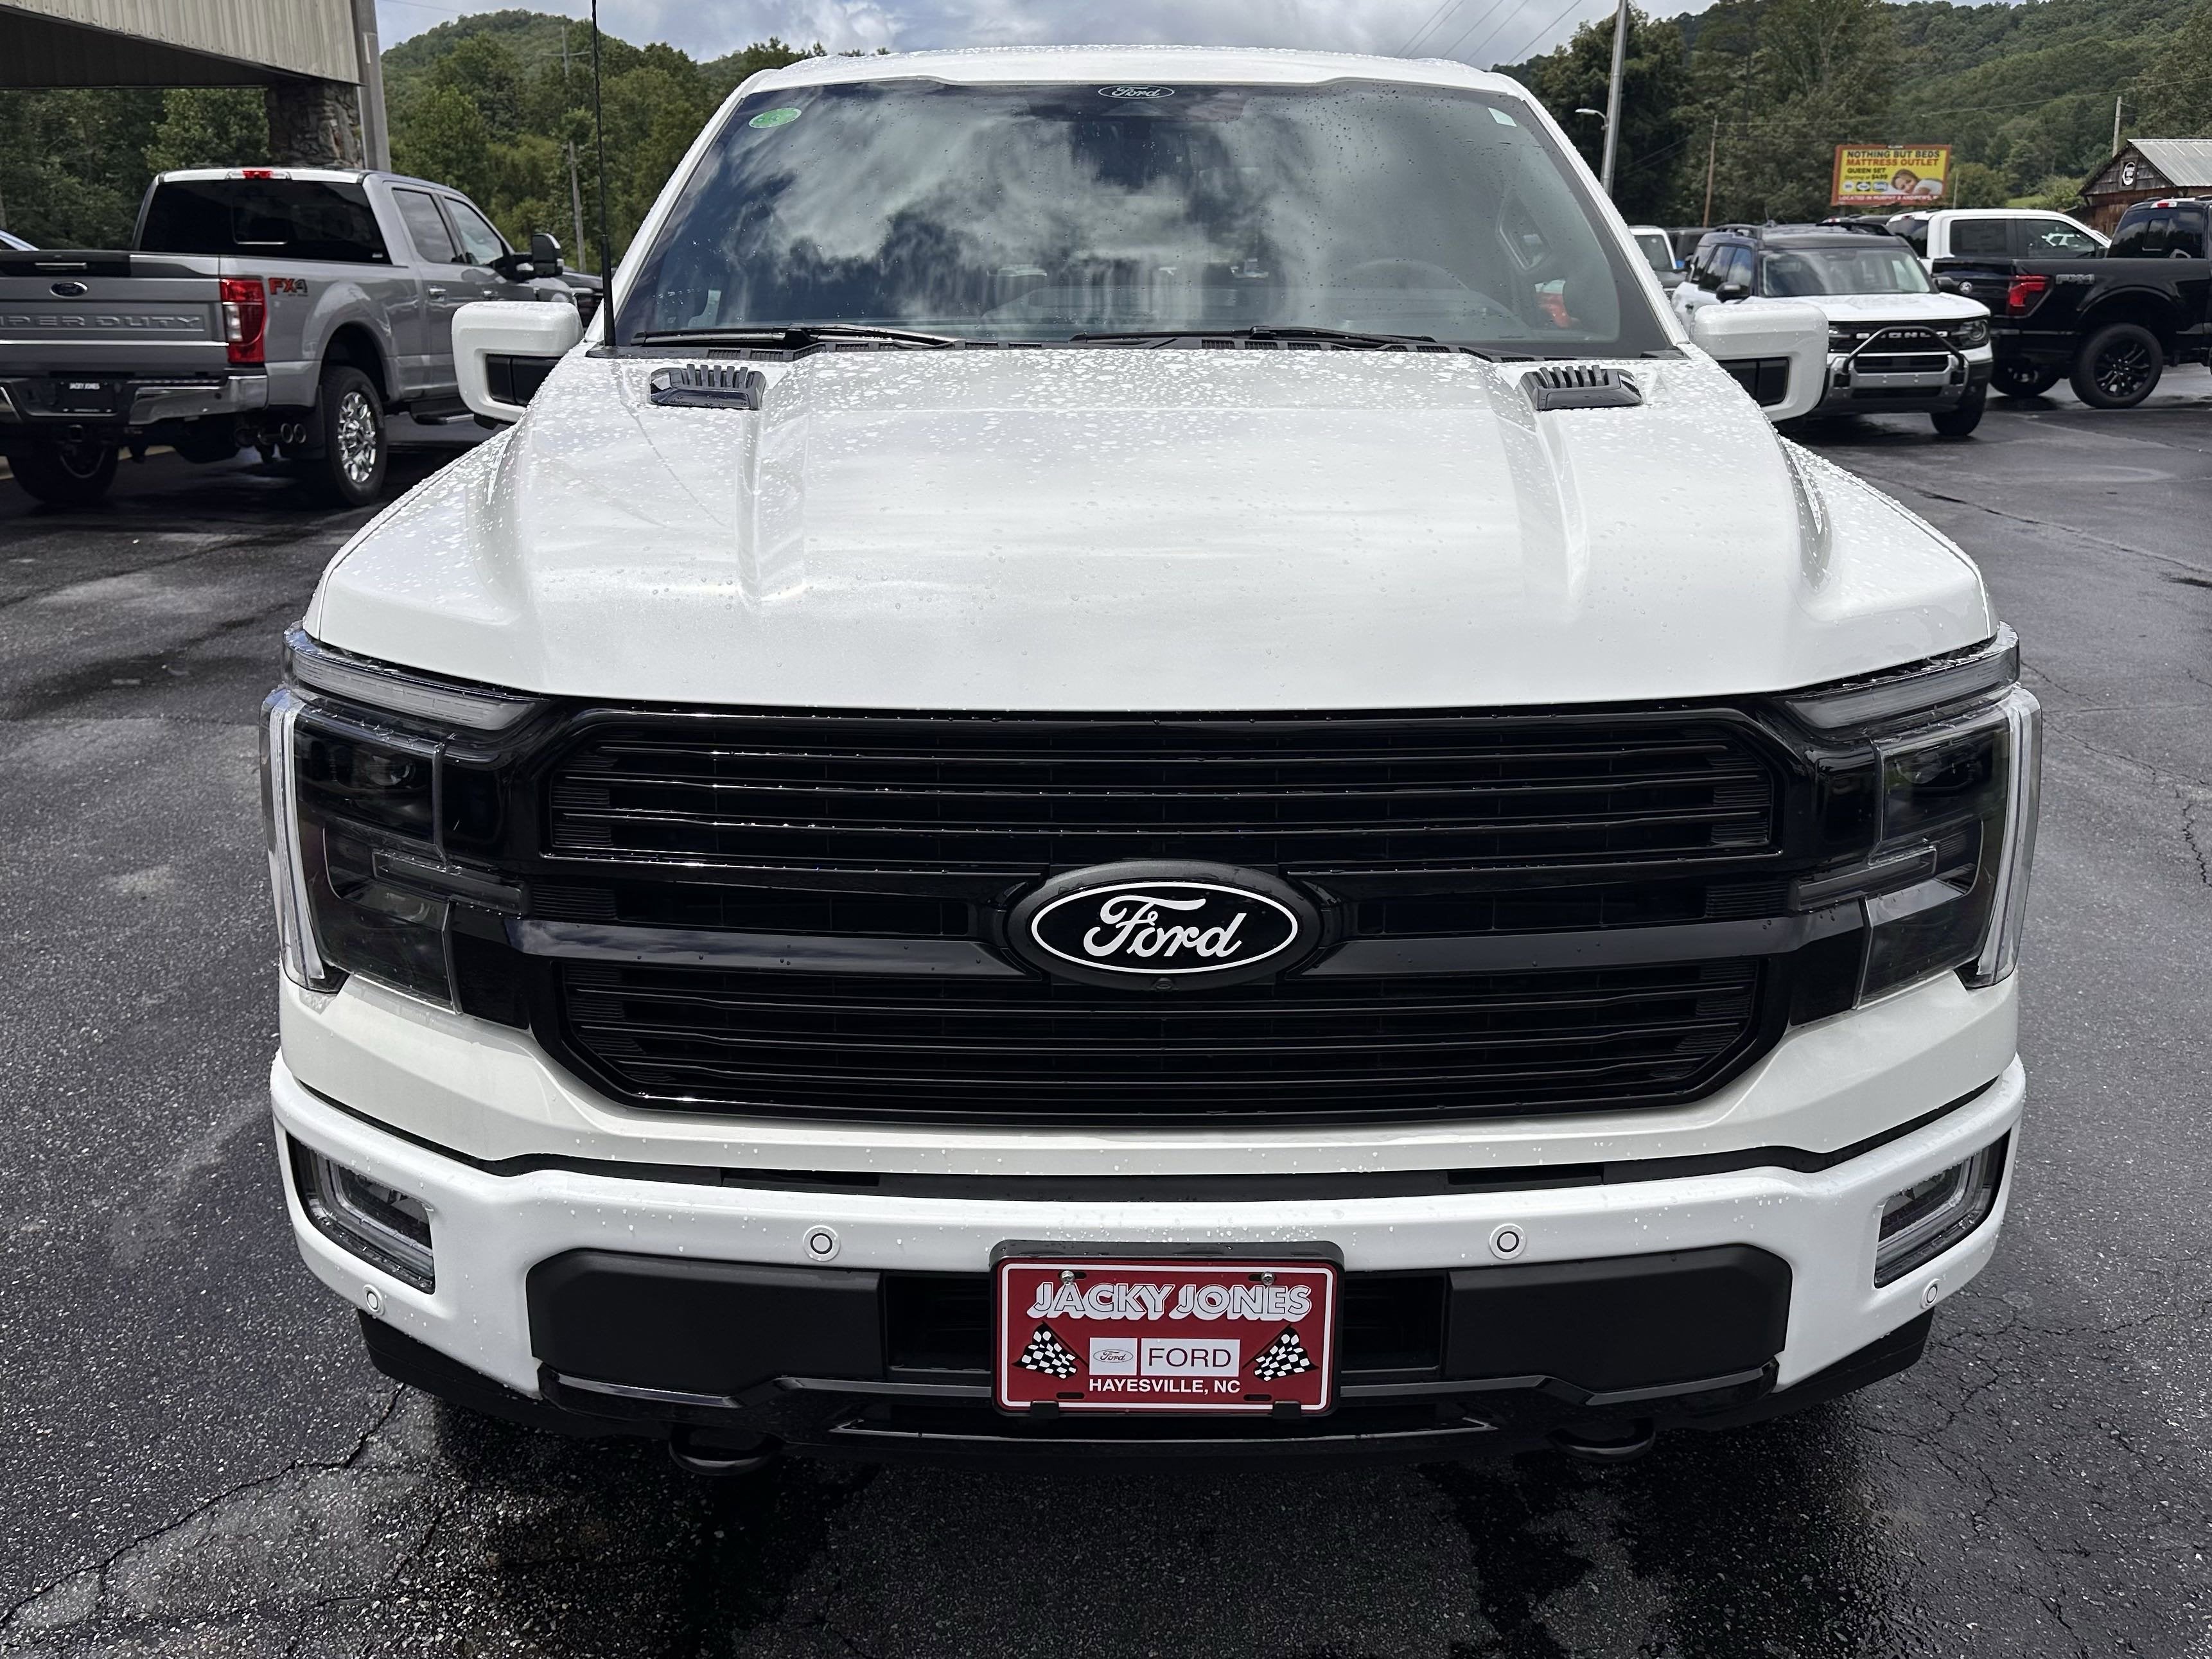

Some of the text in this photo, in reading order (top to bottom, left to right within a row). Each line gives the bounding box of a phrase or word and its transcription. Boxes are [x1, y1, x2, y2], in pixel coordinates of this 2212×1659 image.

[1112, 86, 1161, 97] Ford
[268, 277, 308, 295] FX4
[2056, 274, 2095, 284] FX4
[96, 315, 200, 327] DUTY
[1083, 895, 1247, 958] Ford
[1027, 1282, 1312, 1322] JACKY JONES
[1100, 1350, 1127, 1361] Ford
[1148, 1347, 1232, 1368] FORD
[1089, 1378, 1240, 1395] HAYESVILLE, NC
